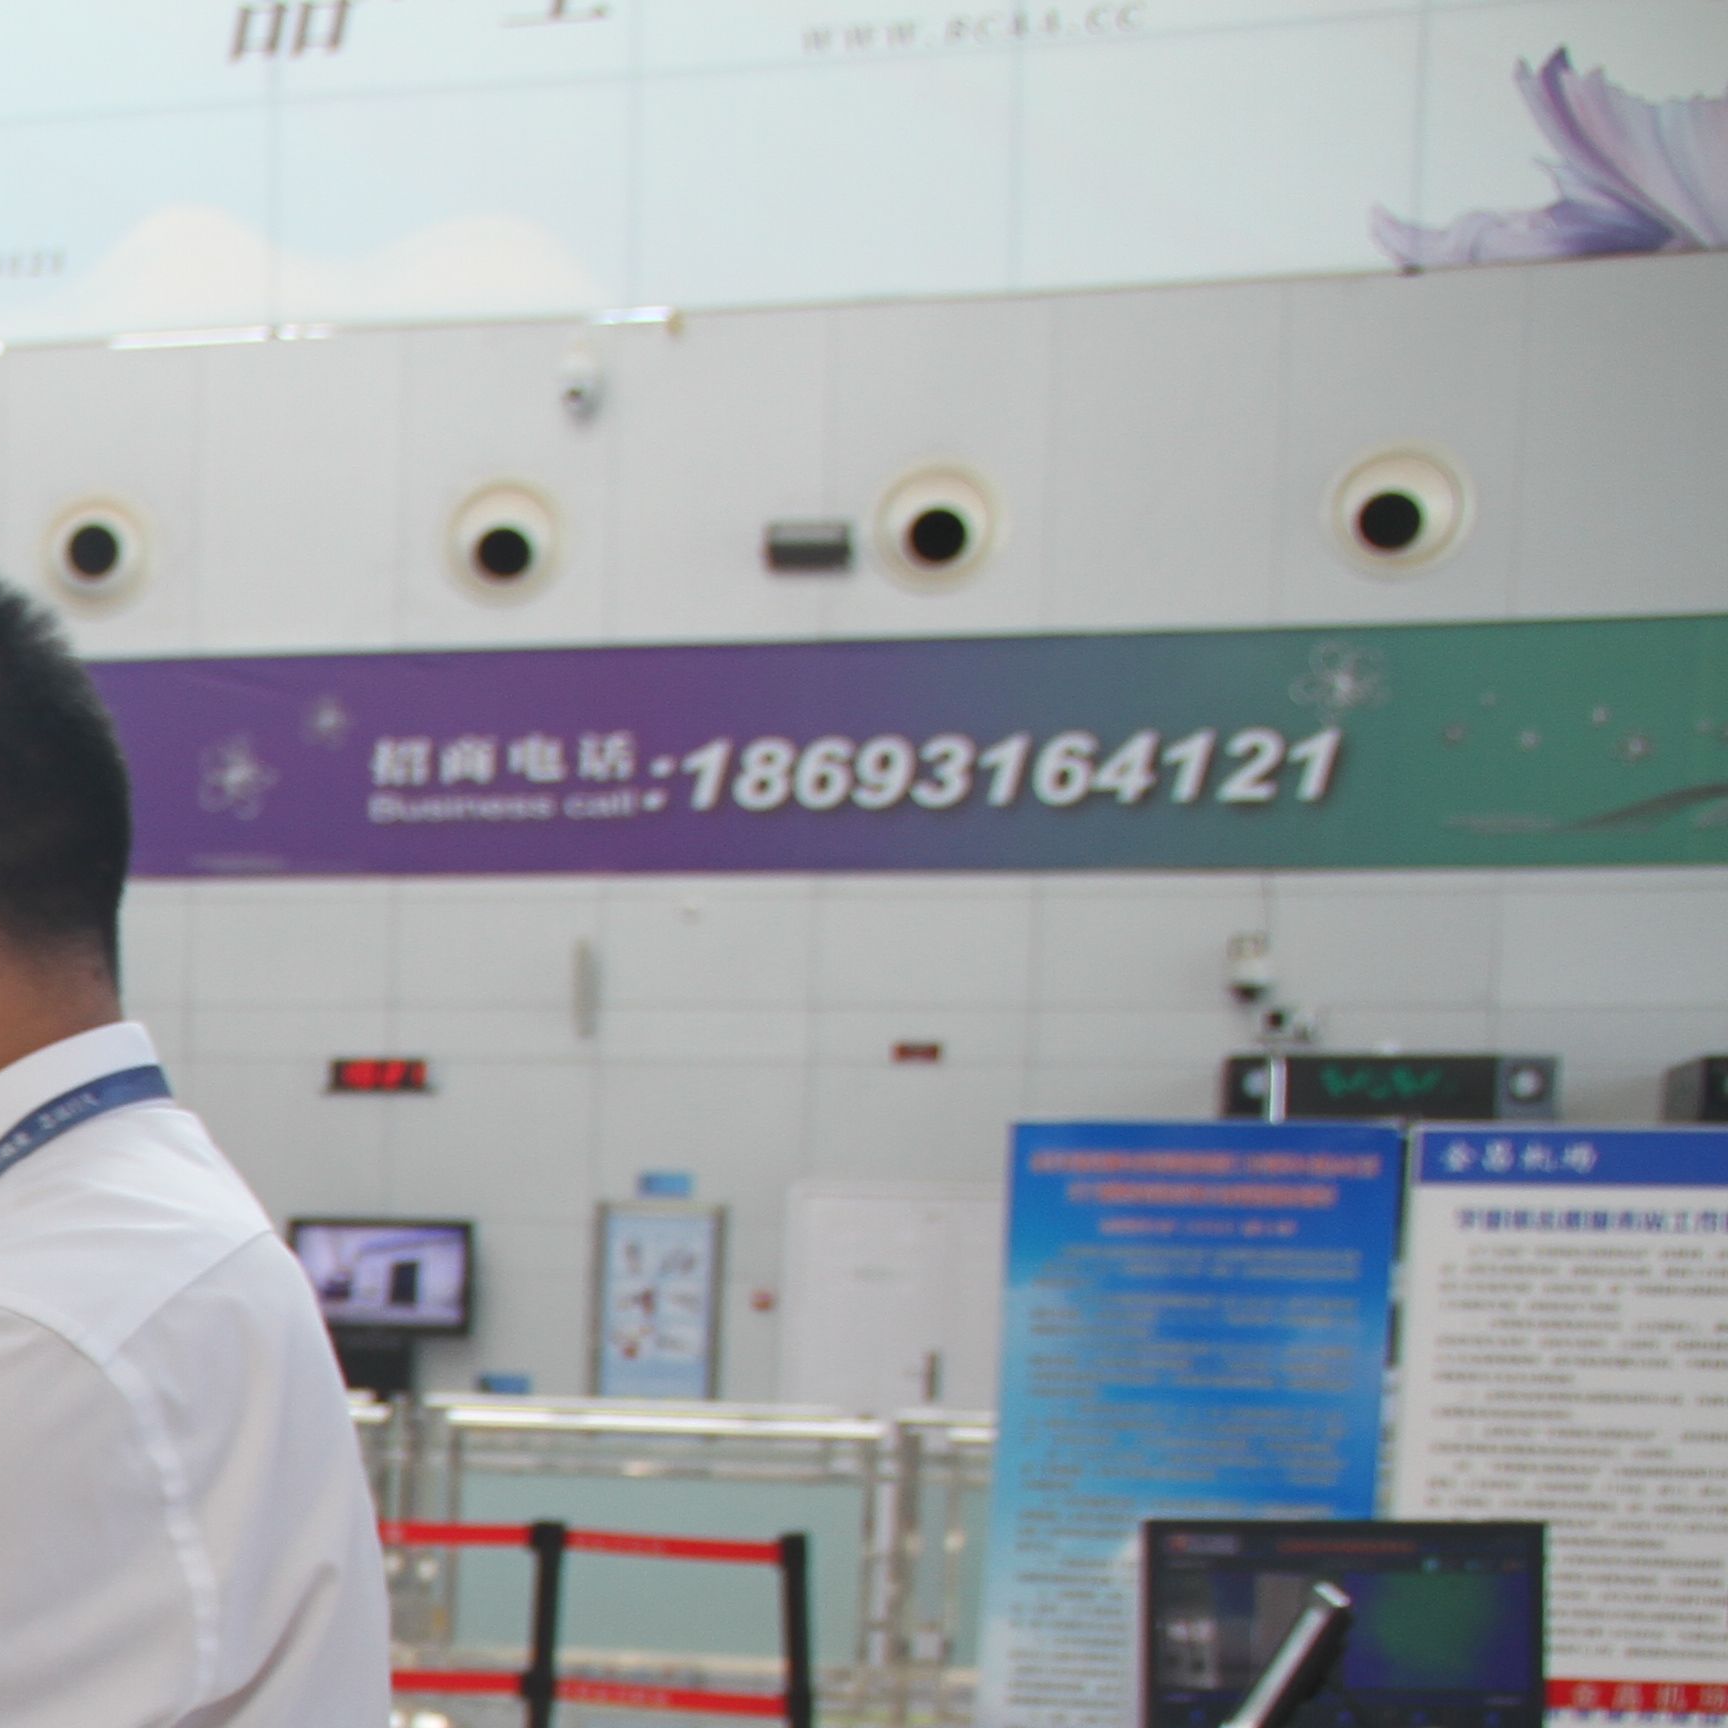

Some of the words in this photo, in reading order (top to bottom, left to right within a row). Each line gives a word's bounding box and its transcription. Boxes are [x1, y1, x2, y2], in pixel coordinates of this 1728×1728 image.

[370, 731, 636, 788] 招商电话
[368, 792, 553, 824] Business
